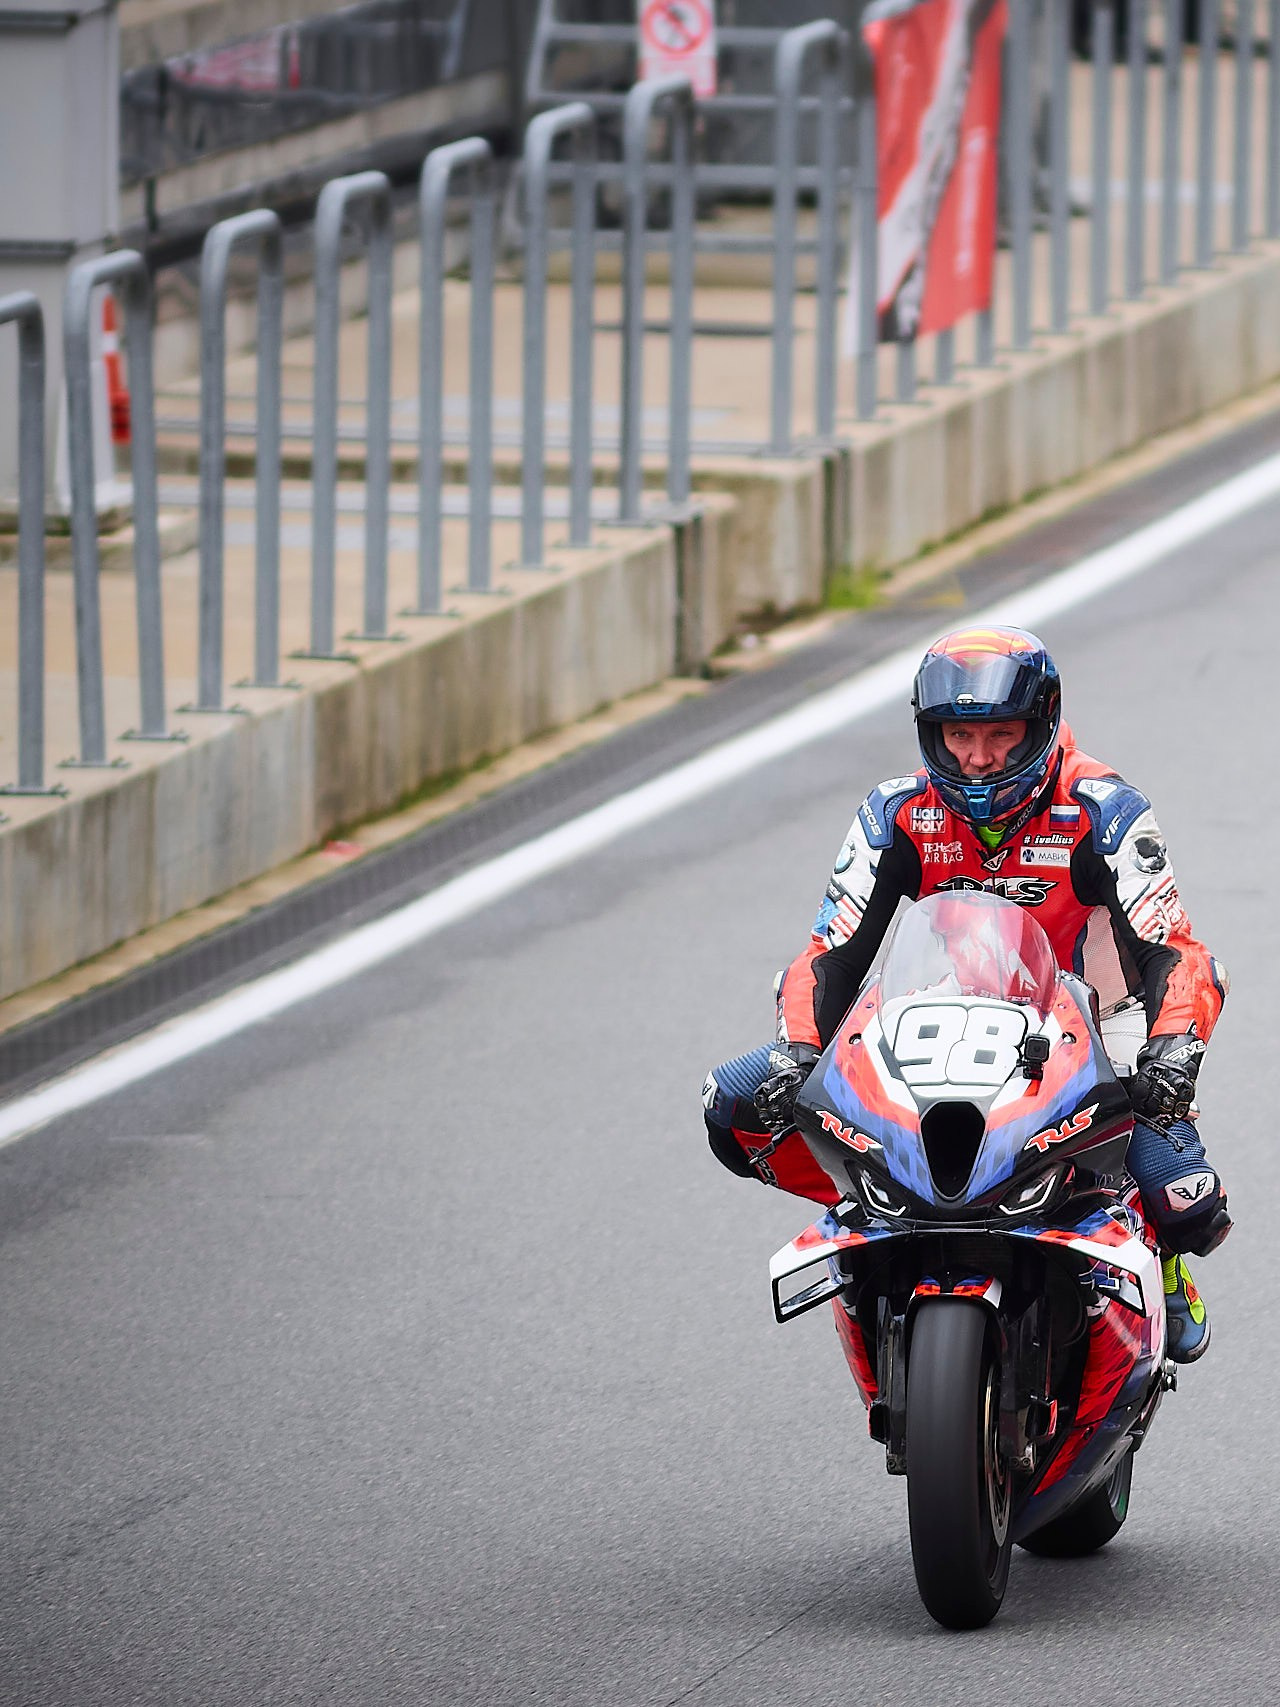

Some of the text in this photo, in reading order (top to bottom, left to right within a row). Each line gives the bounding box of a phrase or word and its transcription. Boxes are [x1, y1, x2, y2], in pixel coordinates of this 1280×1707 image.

[912, 807, 943, 820] LIQUI
[912, 820, 944, 832] MOLY
[943, 851, 964, 864] BAG
[893, 1002, 1029, 1086] 98
